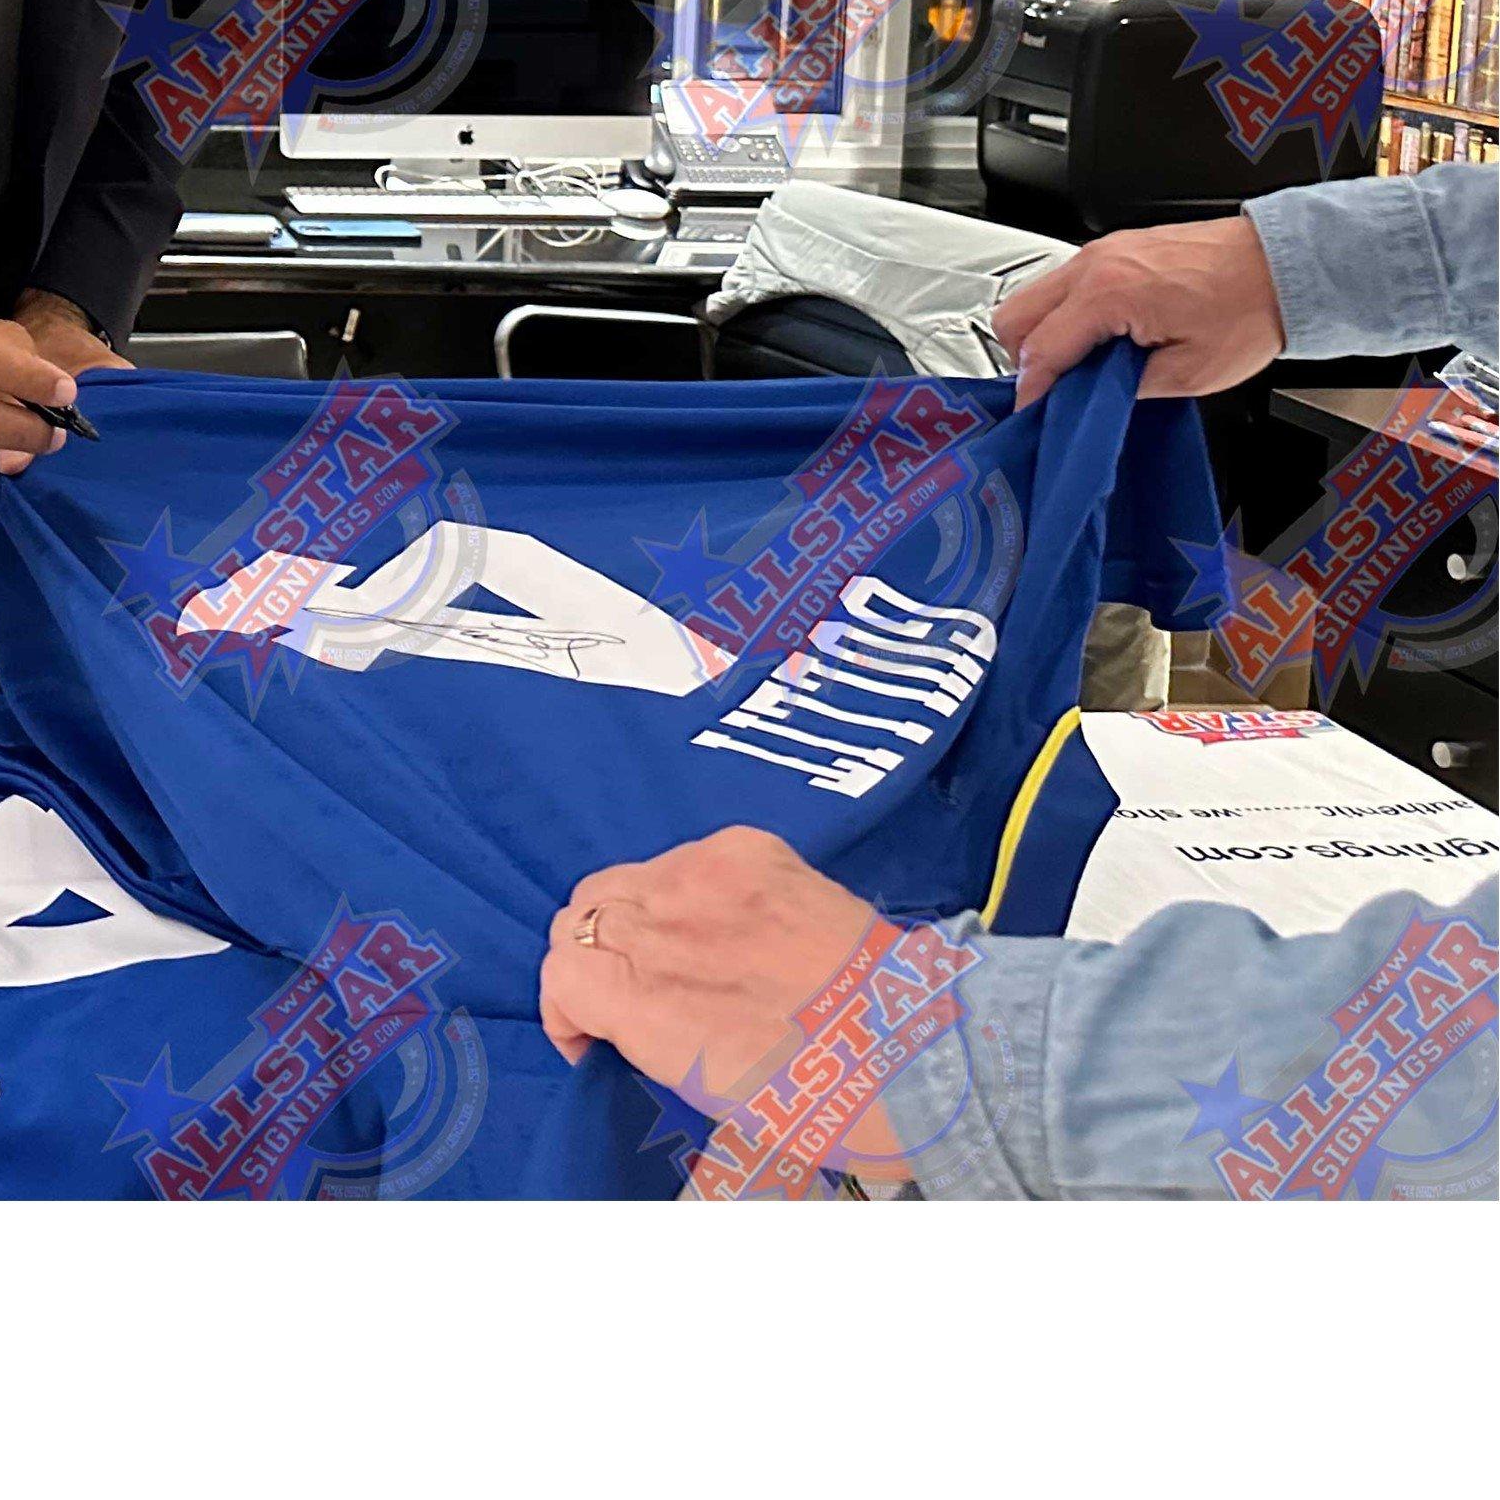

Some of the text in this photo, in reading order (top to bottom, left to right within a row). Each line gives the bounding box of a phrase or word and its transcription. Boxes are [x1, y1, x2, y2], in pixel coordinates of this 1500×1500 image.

[177, 521, 738, 696] 4
[691, 576, 998, 798] GULLIT
[1113, 805, 1182, 822] sho
